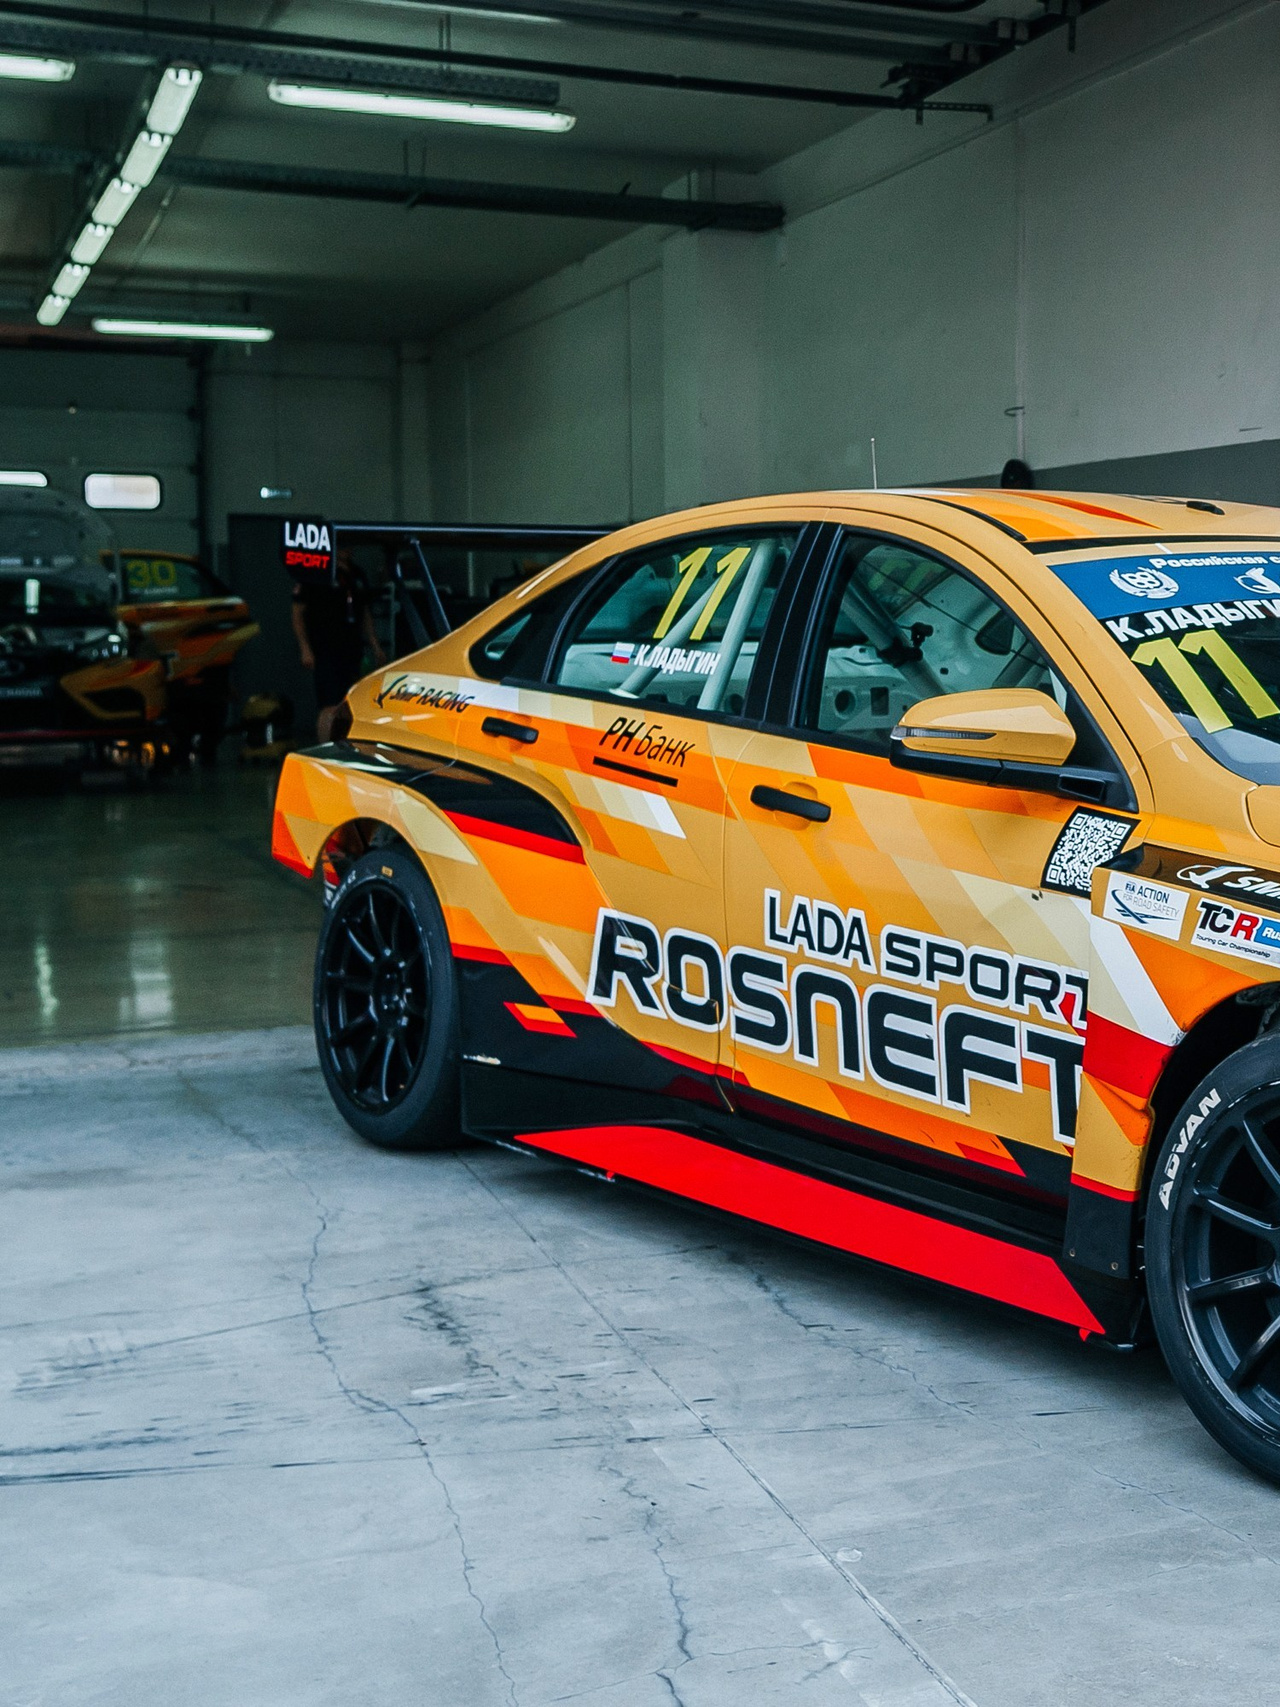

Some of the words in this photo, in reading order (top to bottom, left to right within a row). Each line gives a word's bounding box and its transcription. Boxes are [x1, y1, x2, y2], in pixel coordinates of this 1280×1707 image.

[285, 521, 331, 551] LADA
[127, 560, 176, 588] 30
[286, 551, 330, 569] SPORT
[1149, 556, 1268, 569] Российская
[653, 547, 751, 640] 11
[634, 644, 721, 675] К.ЛАДЫГИН
[416, 688, 475, 713] RACING
[599, 716, 645, 752] РН
[634, 724, 695, 768] Банк
[1125, 882, 1136, 893] FIA
[1137, 886, 1170, 904] ACTION
[1132, 897, 1152, 910] ROAD
[1153, 902, 1180, 918] SAFETY
[1199, 901, 1259, 941] TCR
[764, 888, 877, 974] LADA
[880, 924, 1089, 1030] SPORT
[1196, 934, 1216, 945] Touring
[1229, 942, 1270, 958] Championship
[586, 907, 1087, 1146] ROSNEFT
[1159, 1088, 1221, 1210] ADVAN
